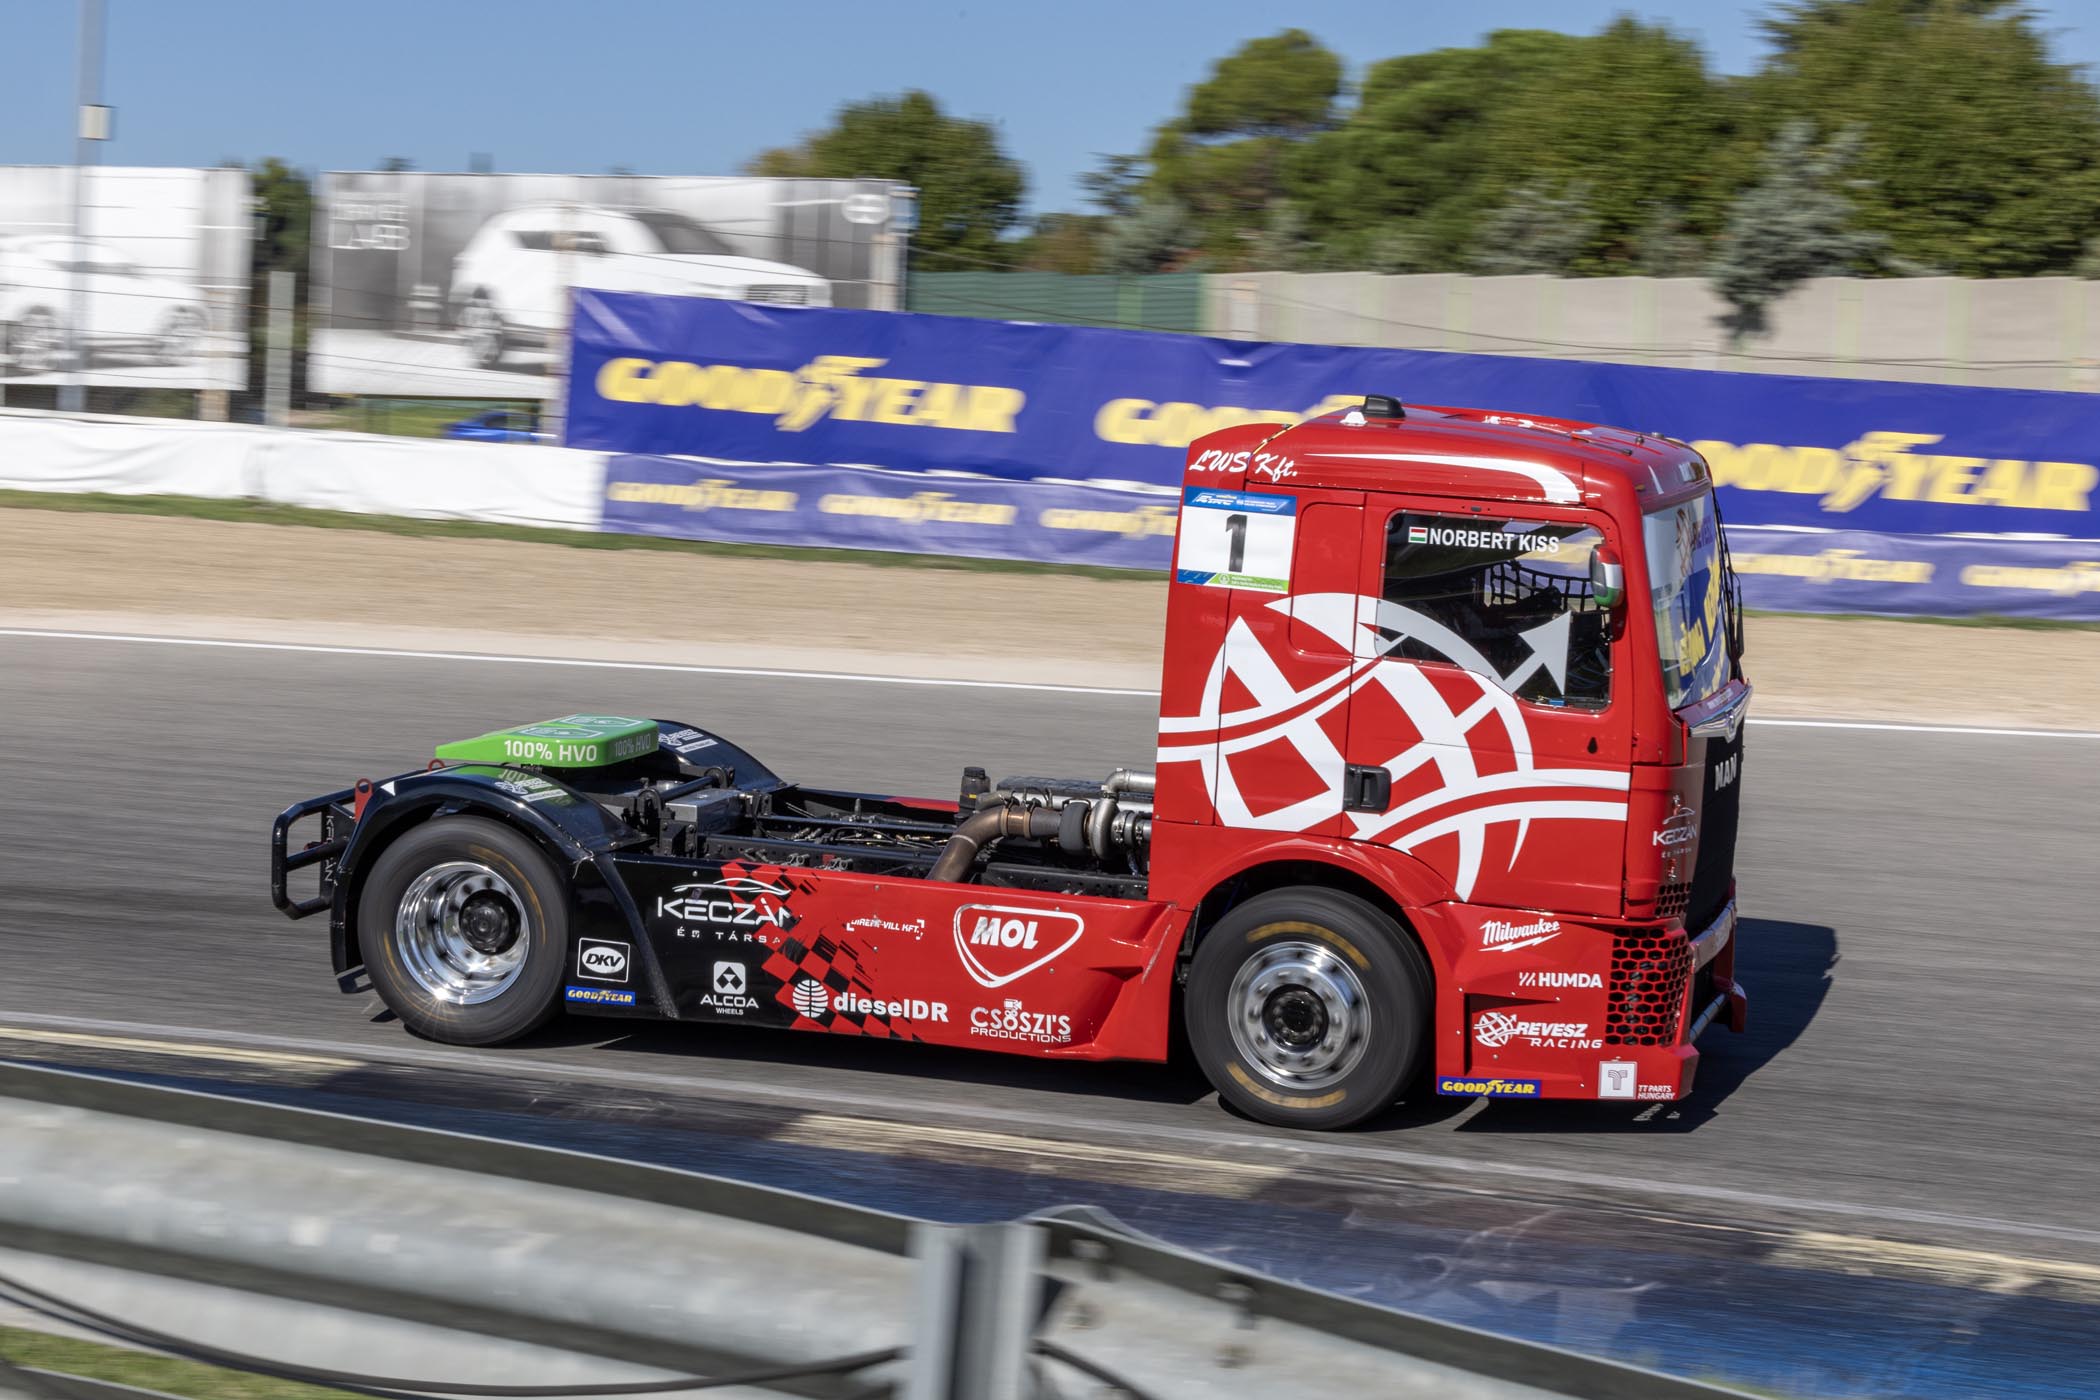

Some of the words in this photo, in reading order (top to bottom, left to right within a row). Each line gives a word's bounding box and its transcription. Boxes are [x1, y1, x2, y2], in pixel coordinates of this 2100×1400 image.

[596, 355, 1026, 432] GOODYEAR
[1189, 450, 1250, 472] LWS
[1255, 453, 1298, 482] Kft.
[1225, 514, 1248, 573] 1
[1430, 527, 1515, 551] NORBERT
[1519, 534, 1560, 553] KISS
[504, 740, 553, 760] 100%
[559, 744, 597, 761] HVO
[970, 916, 1039, 950] MOL
[1479, 919, 1561, 946] Milwaukee
[586, 952, 622, 968] DKV
[1538, 972, 1603, 989] HUMDA
[568, 989, 633, 1004] GOODYEAR
[700, 994, 759, 1010] ALCOA
[716, 1007, 744, 1015] WHEELS
[834, 992, 949, 1023] dieselDR
[970, 1027, 1072, 1043] PRODUCTIONS
[1530, 1038, 1603, 1049] RACING
[1442, 1079, 1536, 1096] GOODYEAR
[1637, 1092, 1675, 1100] HUNGARY
[1649, 1085, 1672, 1093] PARTS
